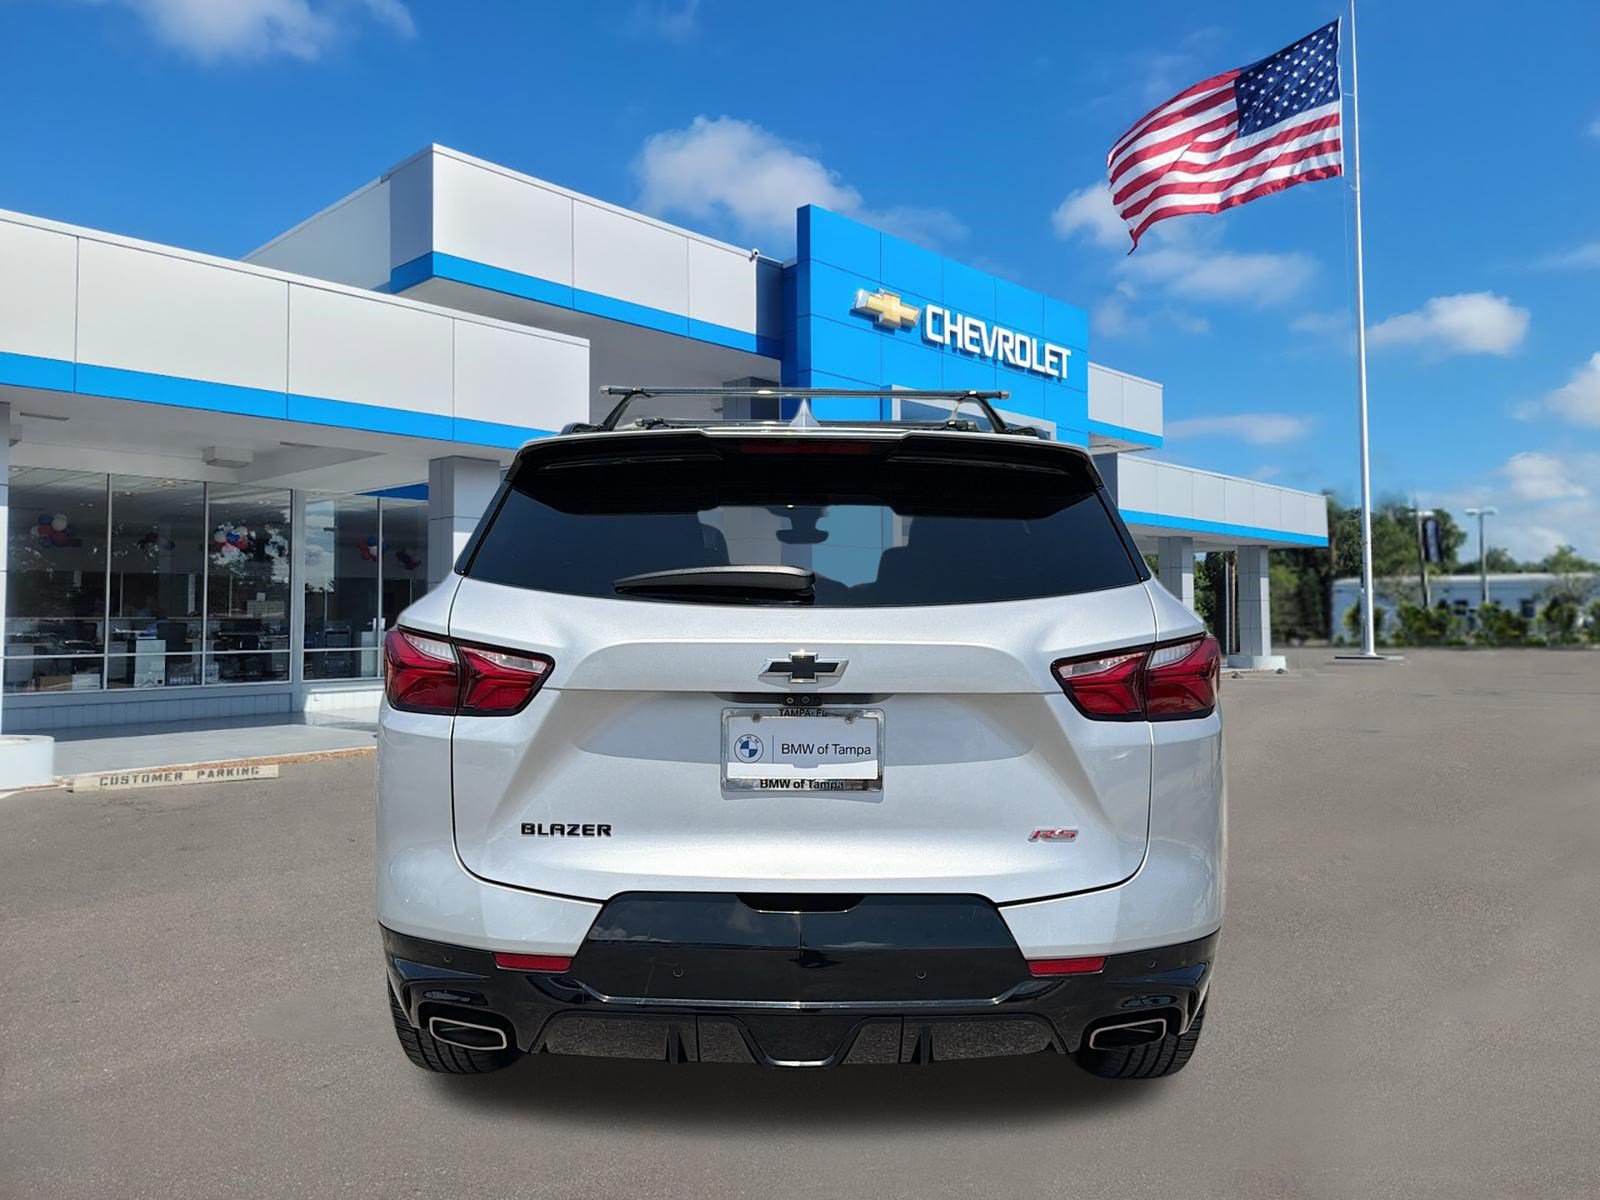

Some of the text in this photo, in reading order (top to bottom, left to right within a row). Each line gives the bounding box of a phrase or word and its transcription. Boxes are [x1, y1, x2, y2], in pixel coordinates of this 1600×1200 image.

[924, 303, 1072, 379] CHEVROLET
[781, 743, 871, 757] BMW of Tampa
[100, 766, 260, 786] CUSTOMER PARKING
[760, 778, 844, 791] BMW of Tampa
[521, 823, 612, 837] BLAZER
[1028, 829, 1079, 843] RS
